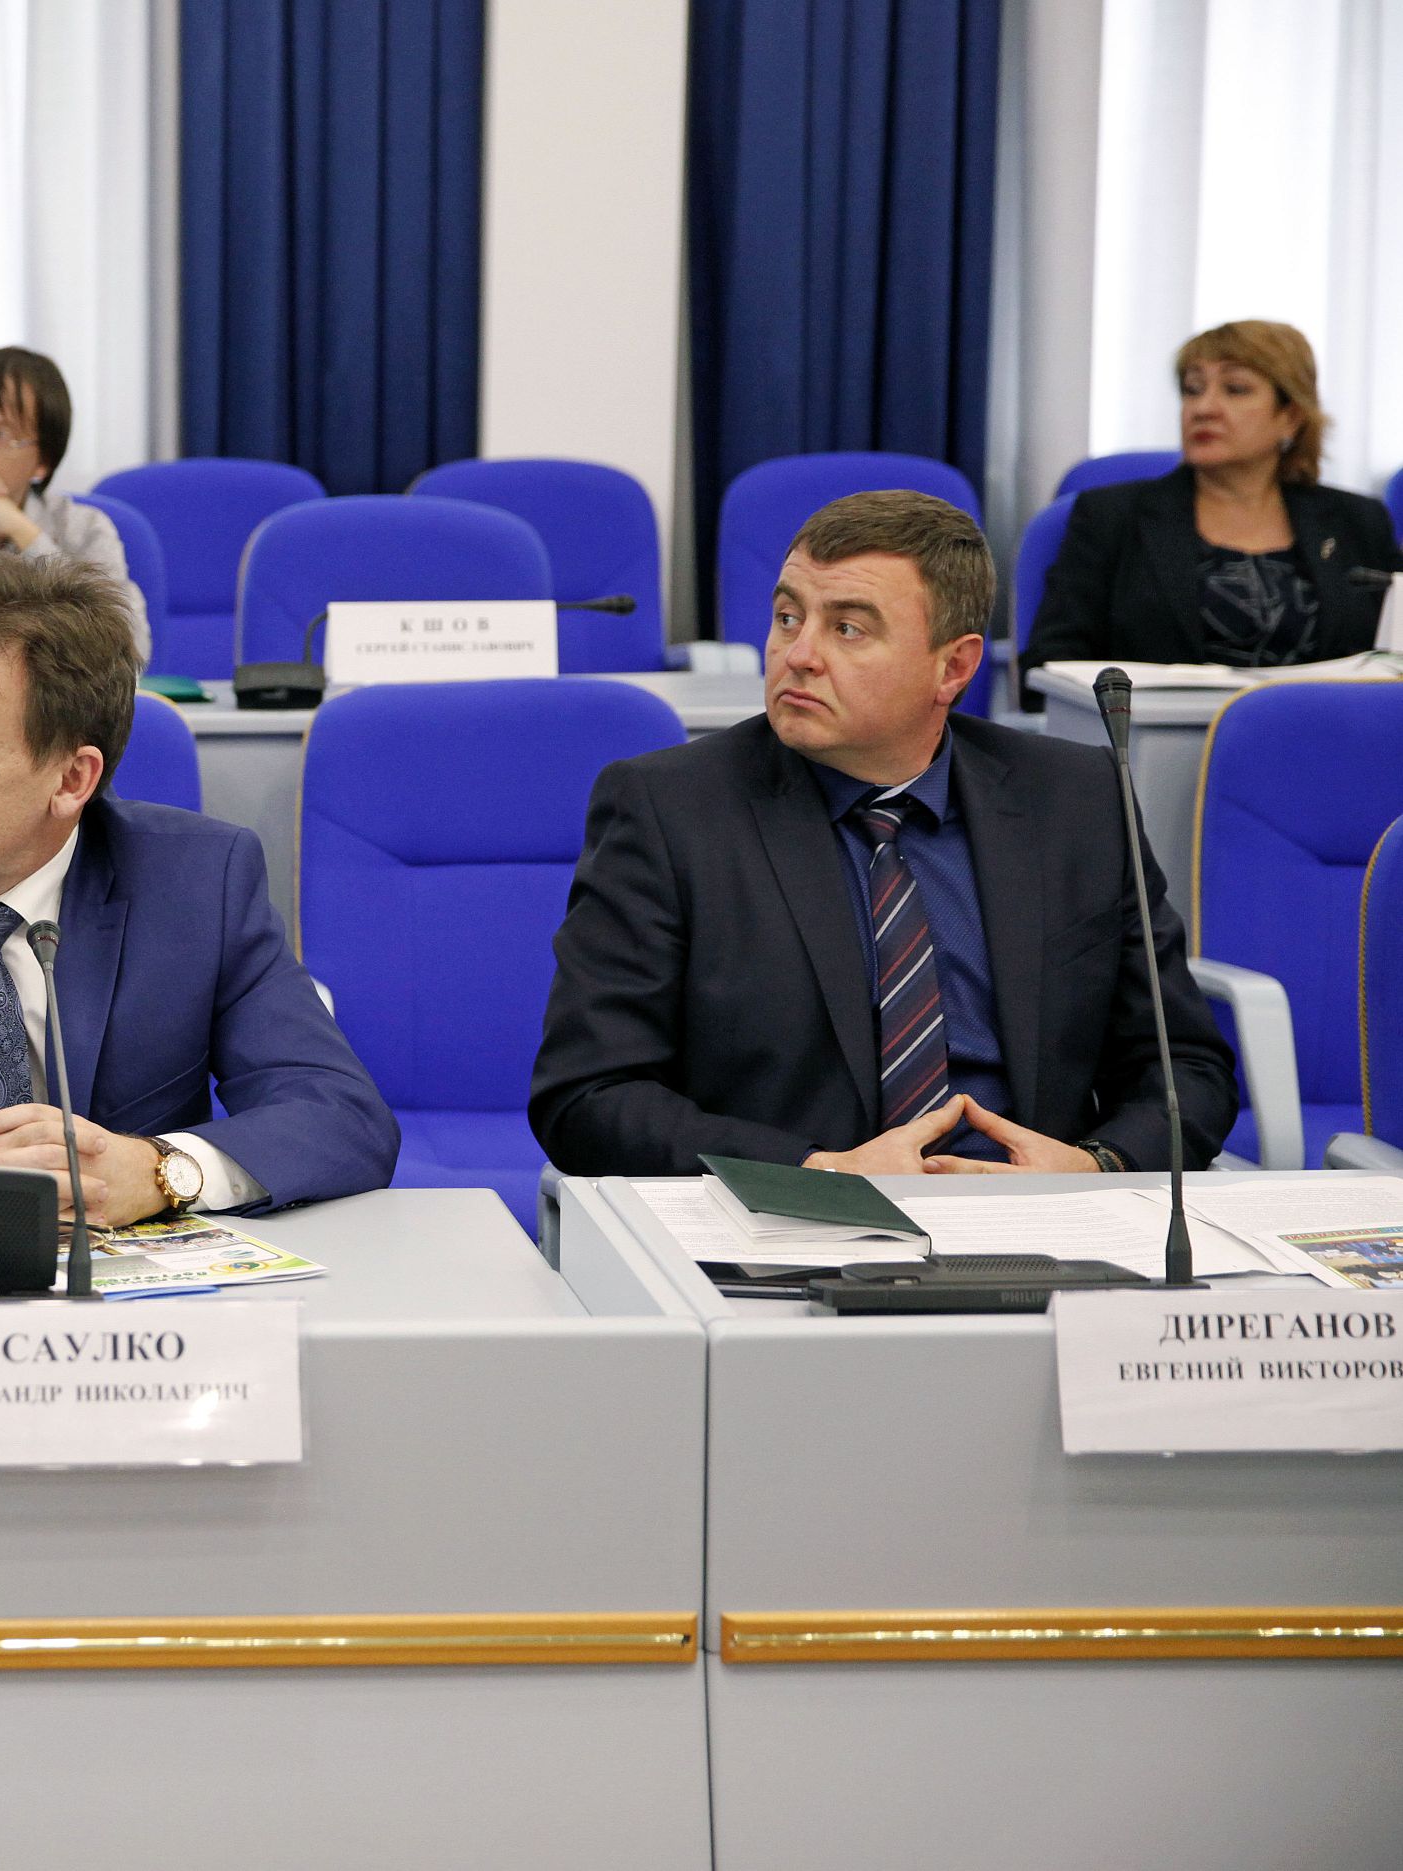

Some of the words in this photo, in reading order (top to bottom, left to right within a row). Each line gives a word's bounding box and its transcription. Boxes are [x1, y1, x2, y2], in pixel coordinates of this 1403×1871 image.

[1001, 1290, 1047, 1304] PHILIP
[1159, 1312, 1397, 1347] ДИРЕГАНОВ
[1118, 1357, 1244, 1381] ЕВГЕНИЙ
